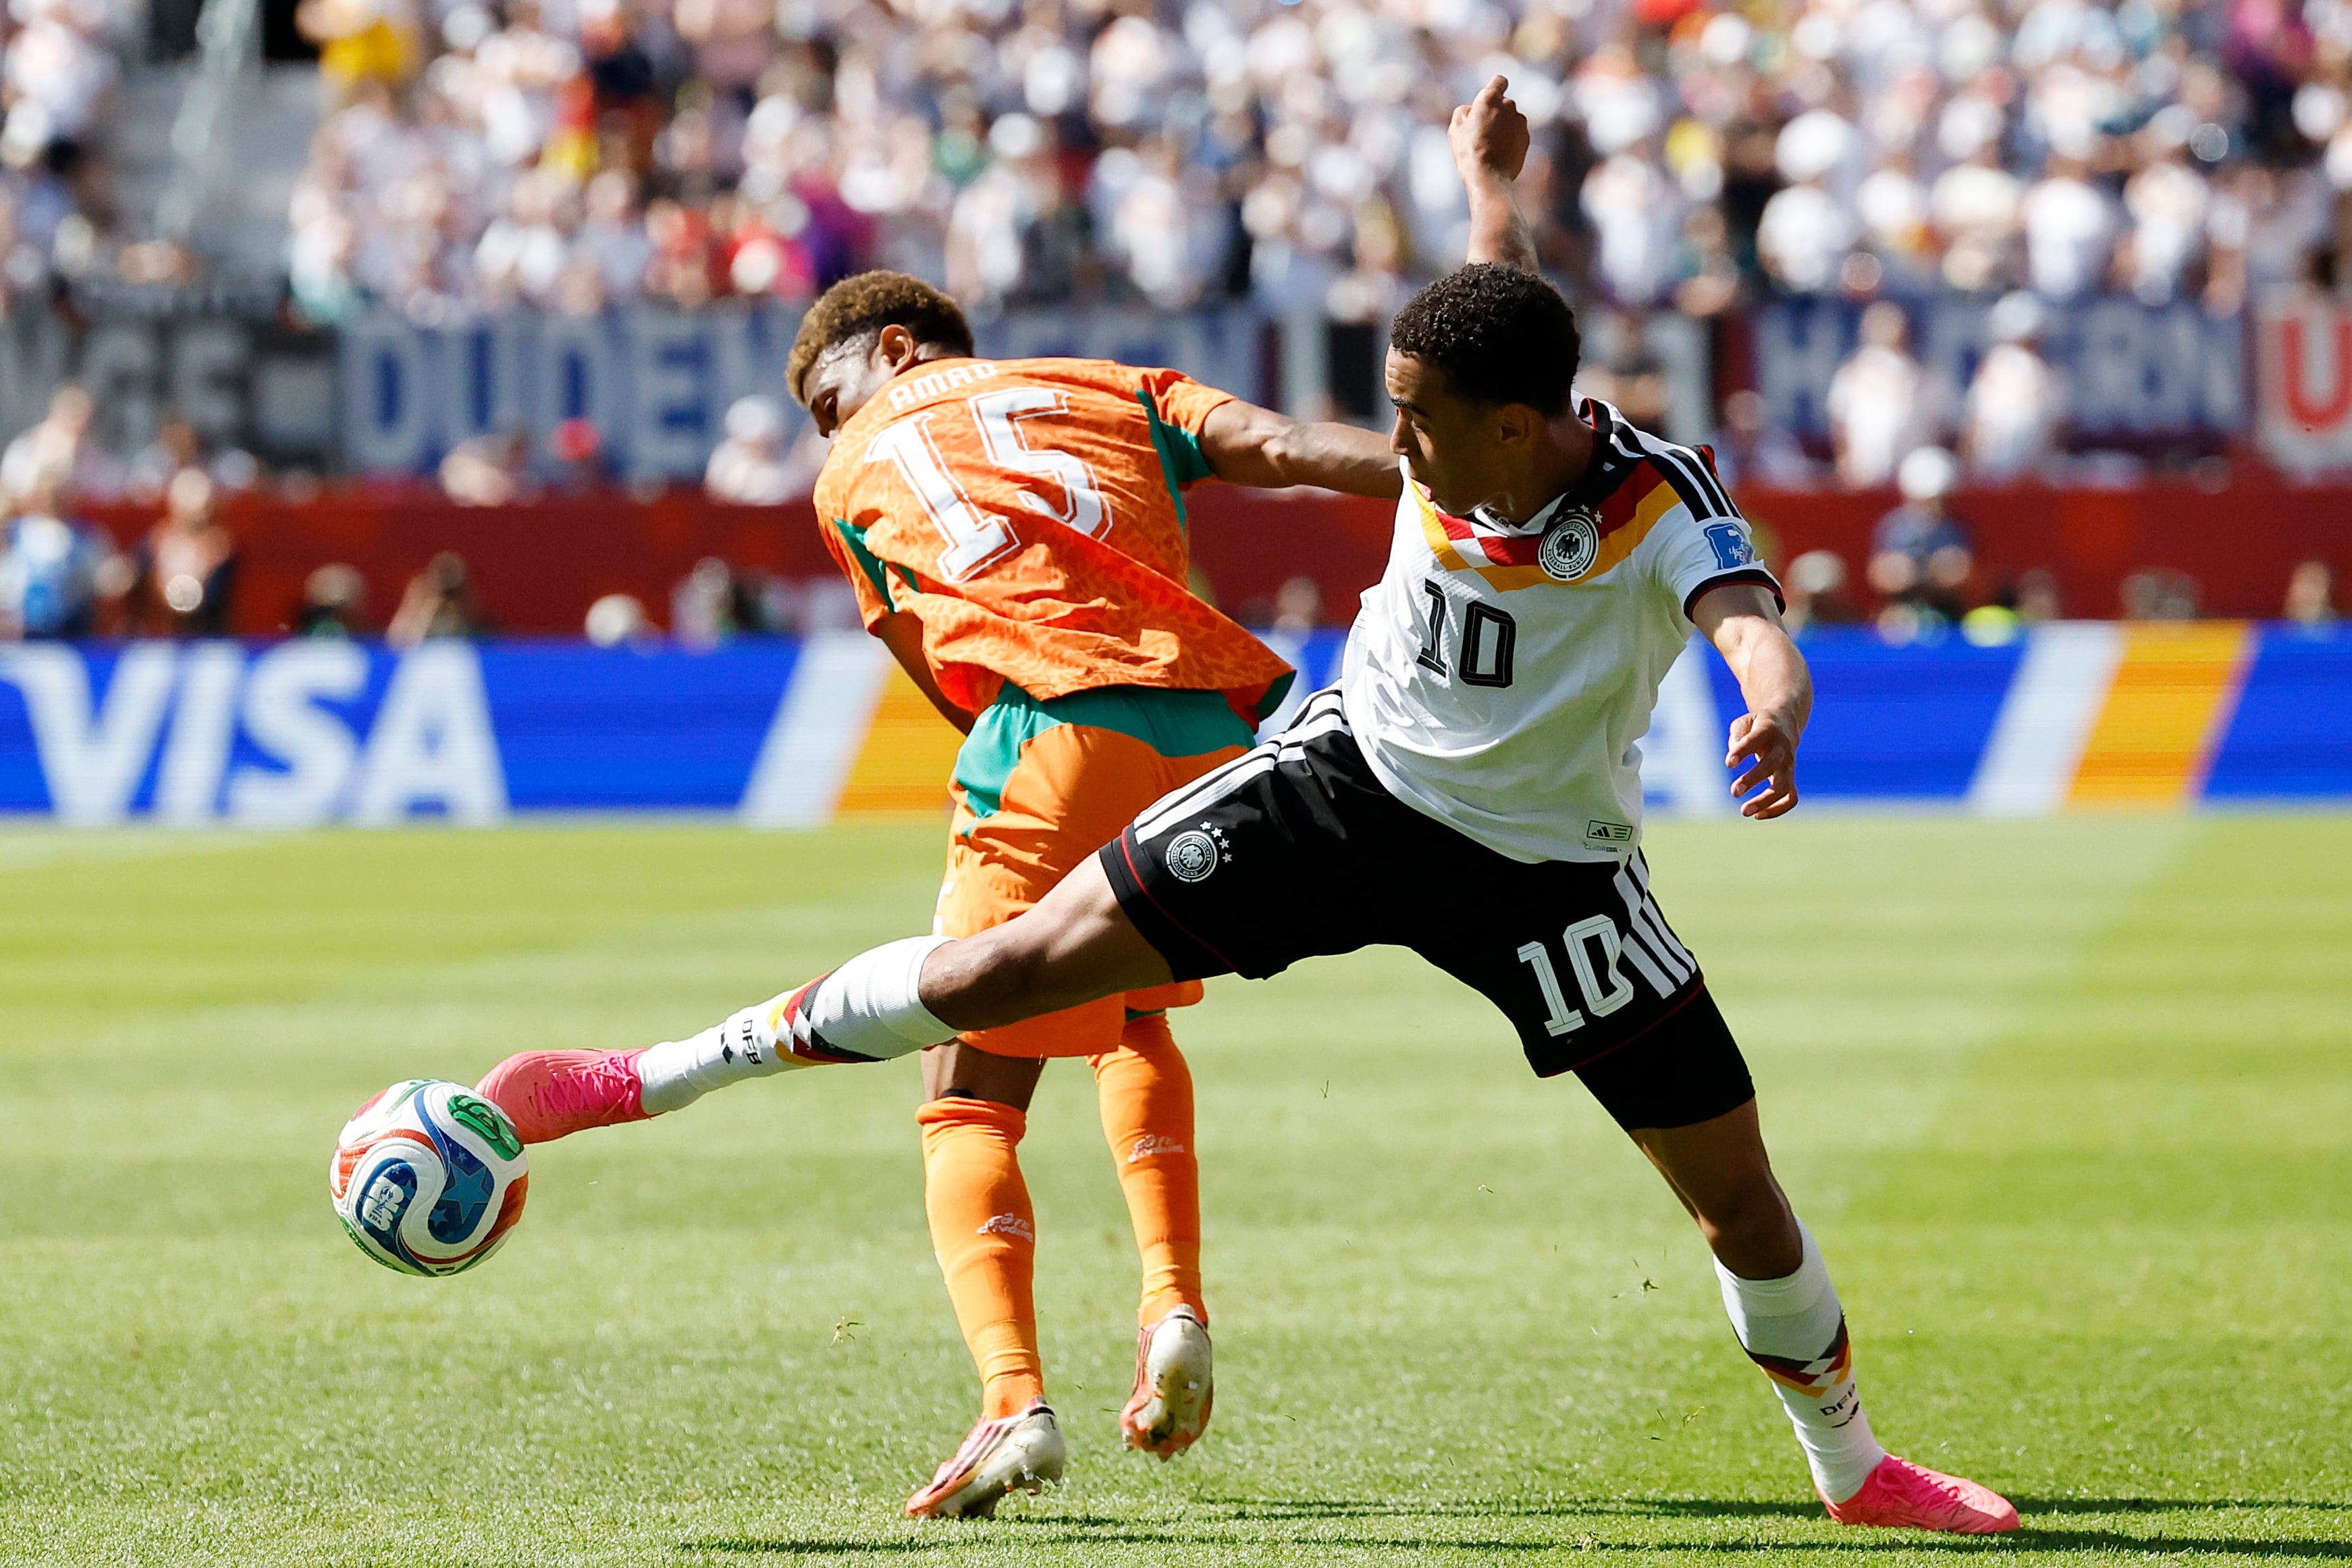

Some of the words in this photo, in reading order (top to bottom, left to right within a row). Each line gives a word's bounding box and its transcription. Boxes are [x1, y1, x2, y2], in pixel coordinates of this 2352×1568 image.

[888, 363, 998, 411] AMAD
[863, 386, 1113, 584] 15
[1416, 577, 1517, 689] 10
[0, 637, 510, 828] VISA
[1517, 913, 1634, 1037] 10
[742, 1019, 762, 1064] DFB
